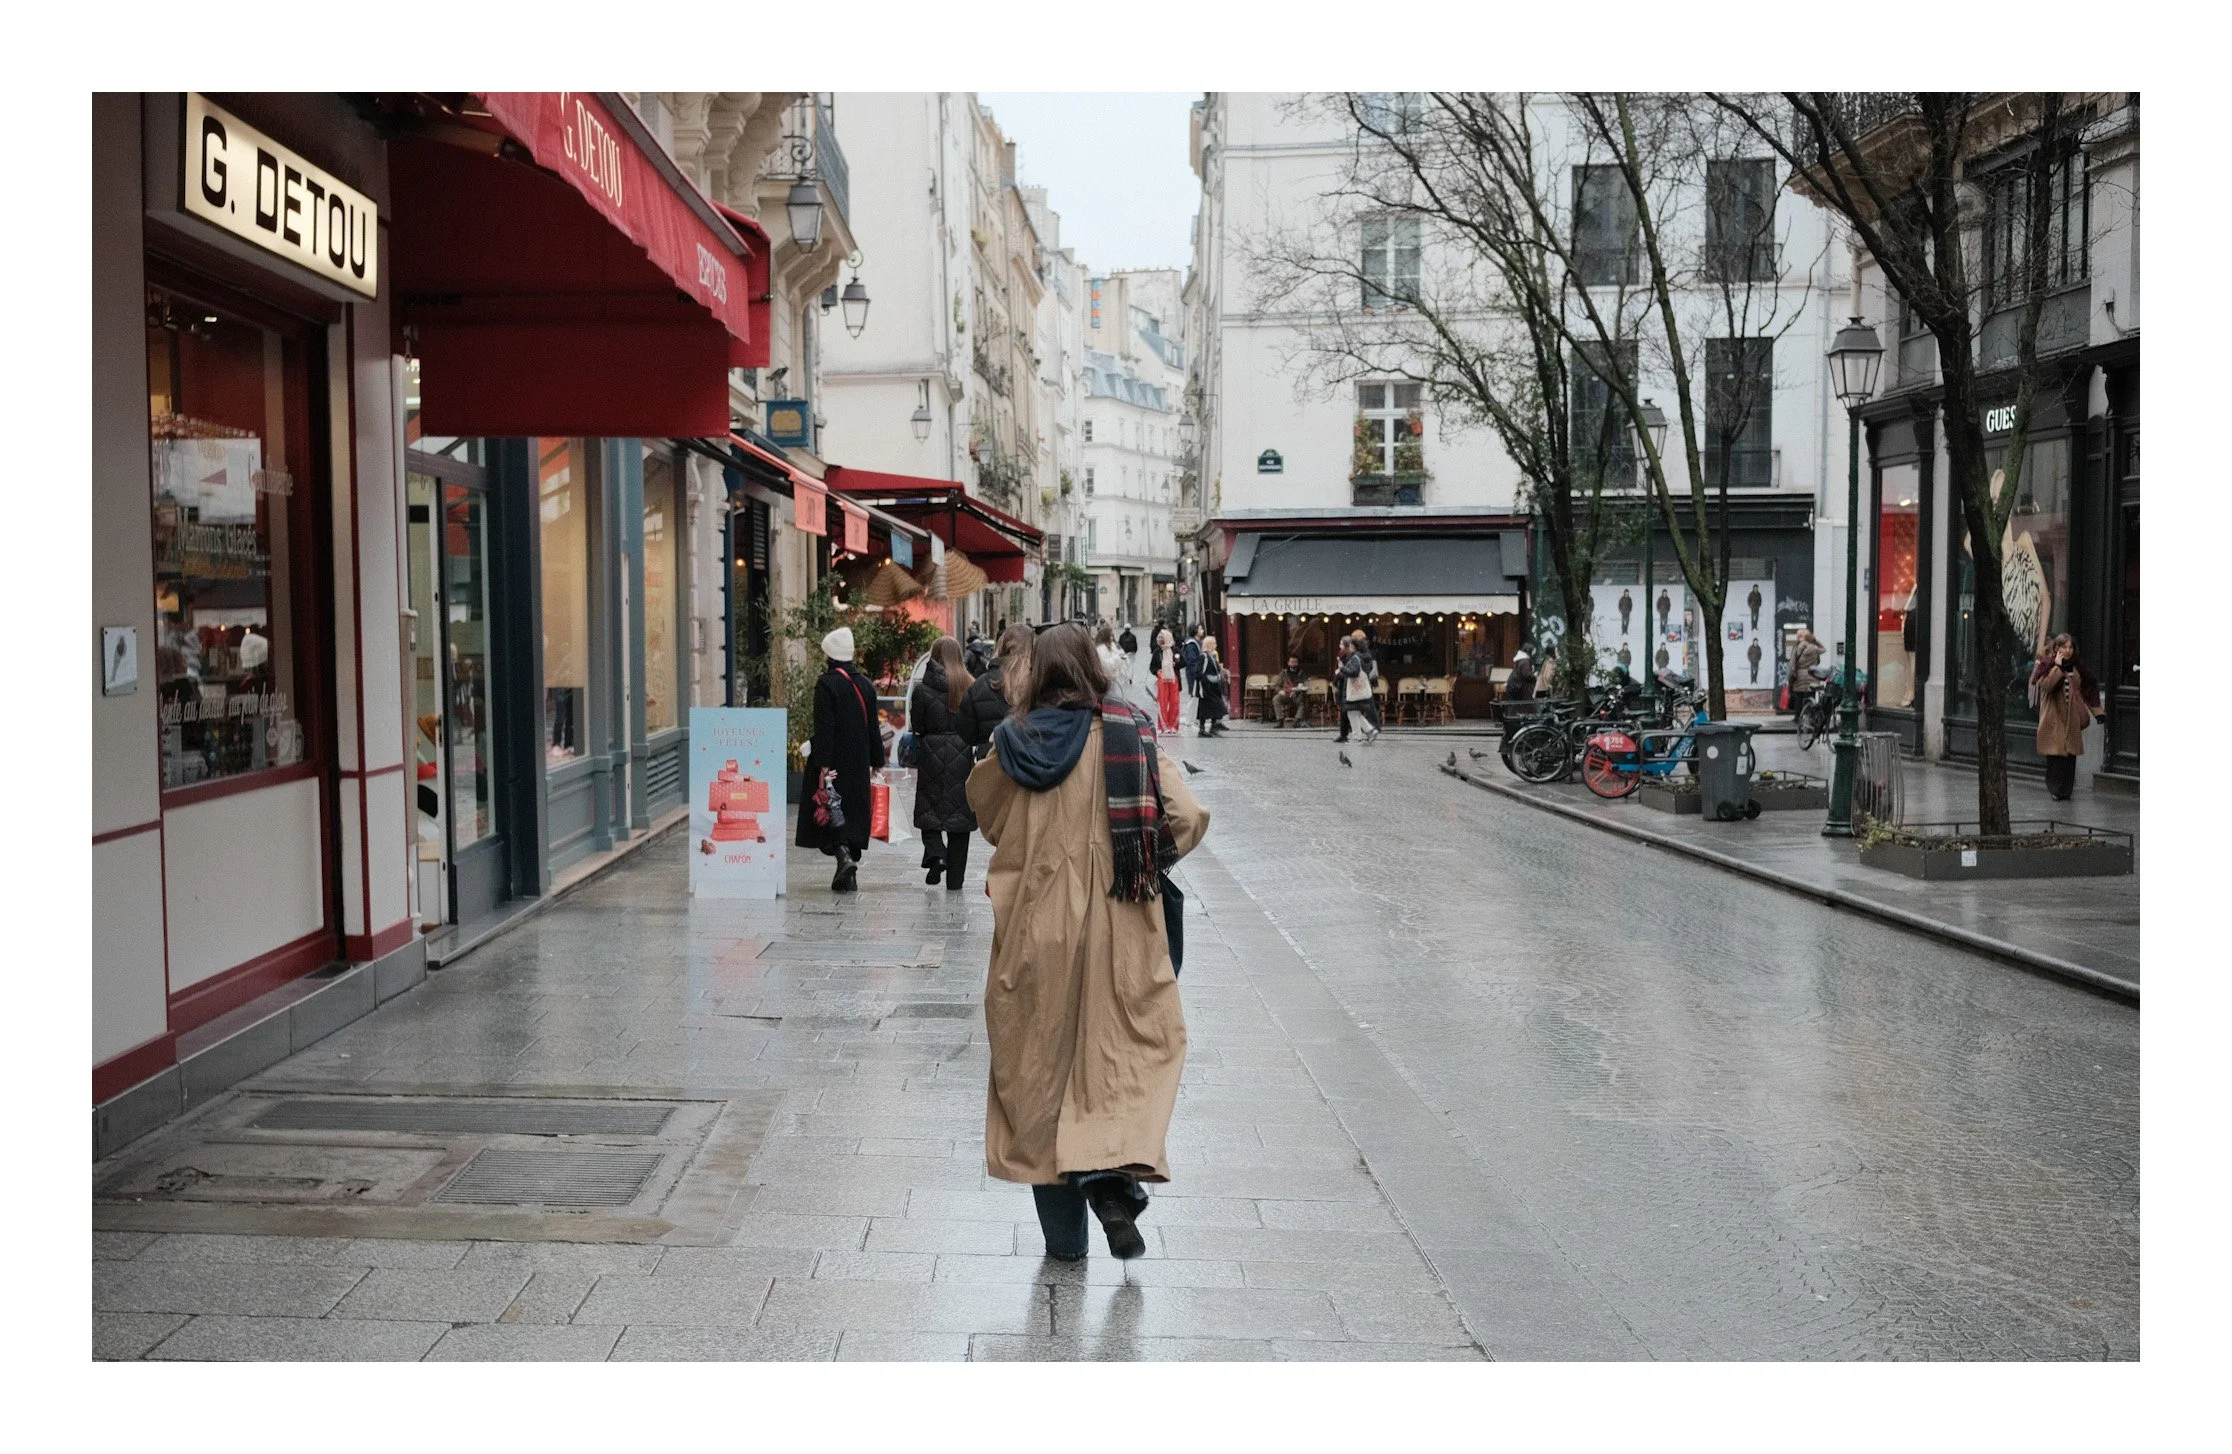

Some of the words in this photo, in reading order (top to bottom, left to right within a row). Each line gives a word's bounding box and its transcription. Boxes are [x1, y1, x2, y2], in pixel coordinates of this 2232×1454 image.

[561, 92, 576, 161] G.
[576, 99, 622, 207] DETOU
[201, 115, 235, 214] G.
[256, 147, 366, 279] DETOU
[1986, 405, 2017, 432] GUES
[177, 504, 221, 555] Marrons
[1252, 599, 1269, 611] LA
[1274, 599, 1323, 611] GRILLE
[1372, 634, 1418, 646] BRASSERIE
[183, 700, 198, 722] au
[228, 696, 241, 718] au
[259, 681, 269, 716] de
[712, 728, 766, 736] JOYEUSES
[724, 855, 752, 864] CHAPON
